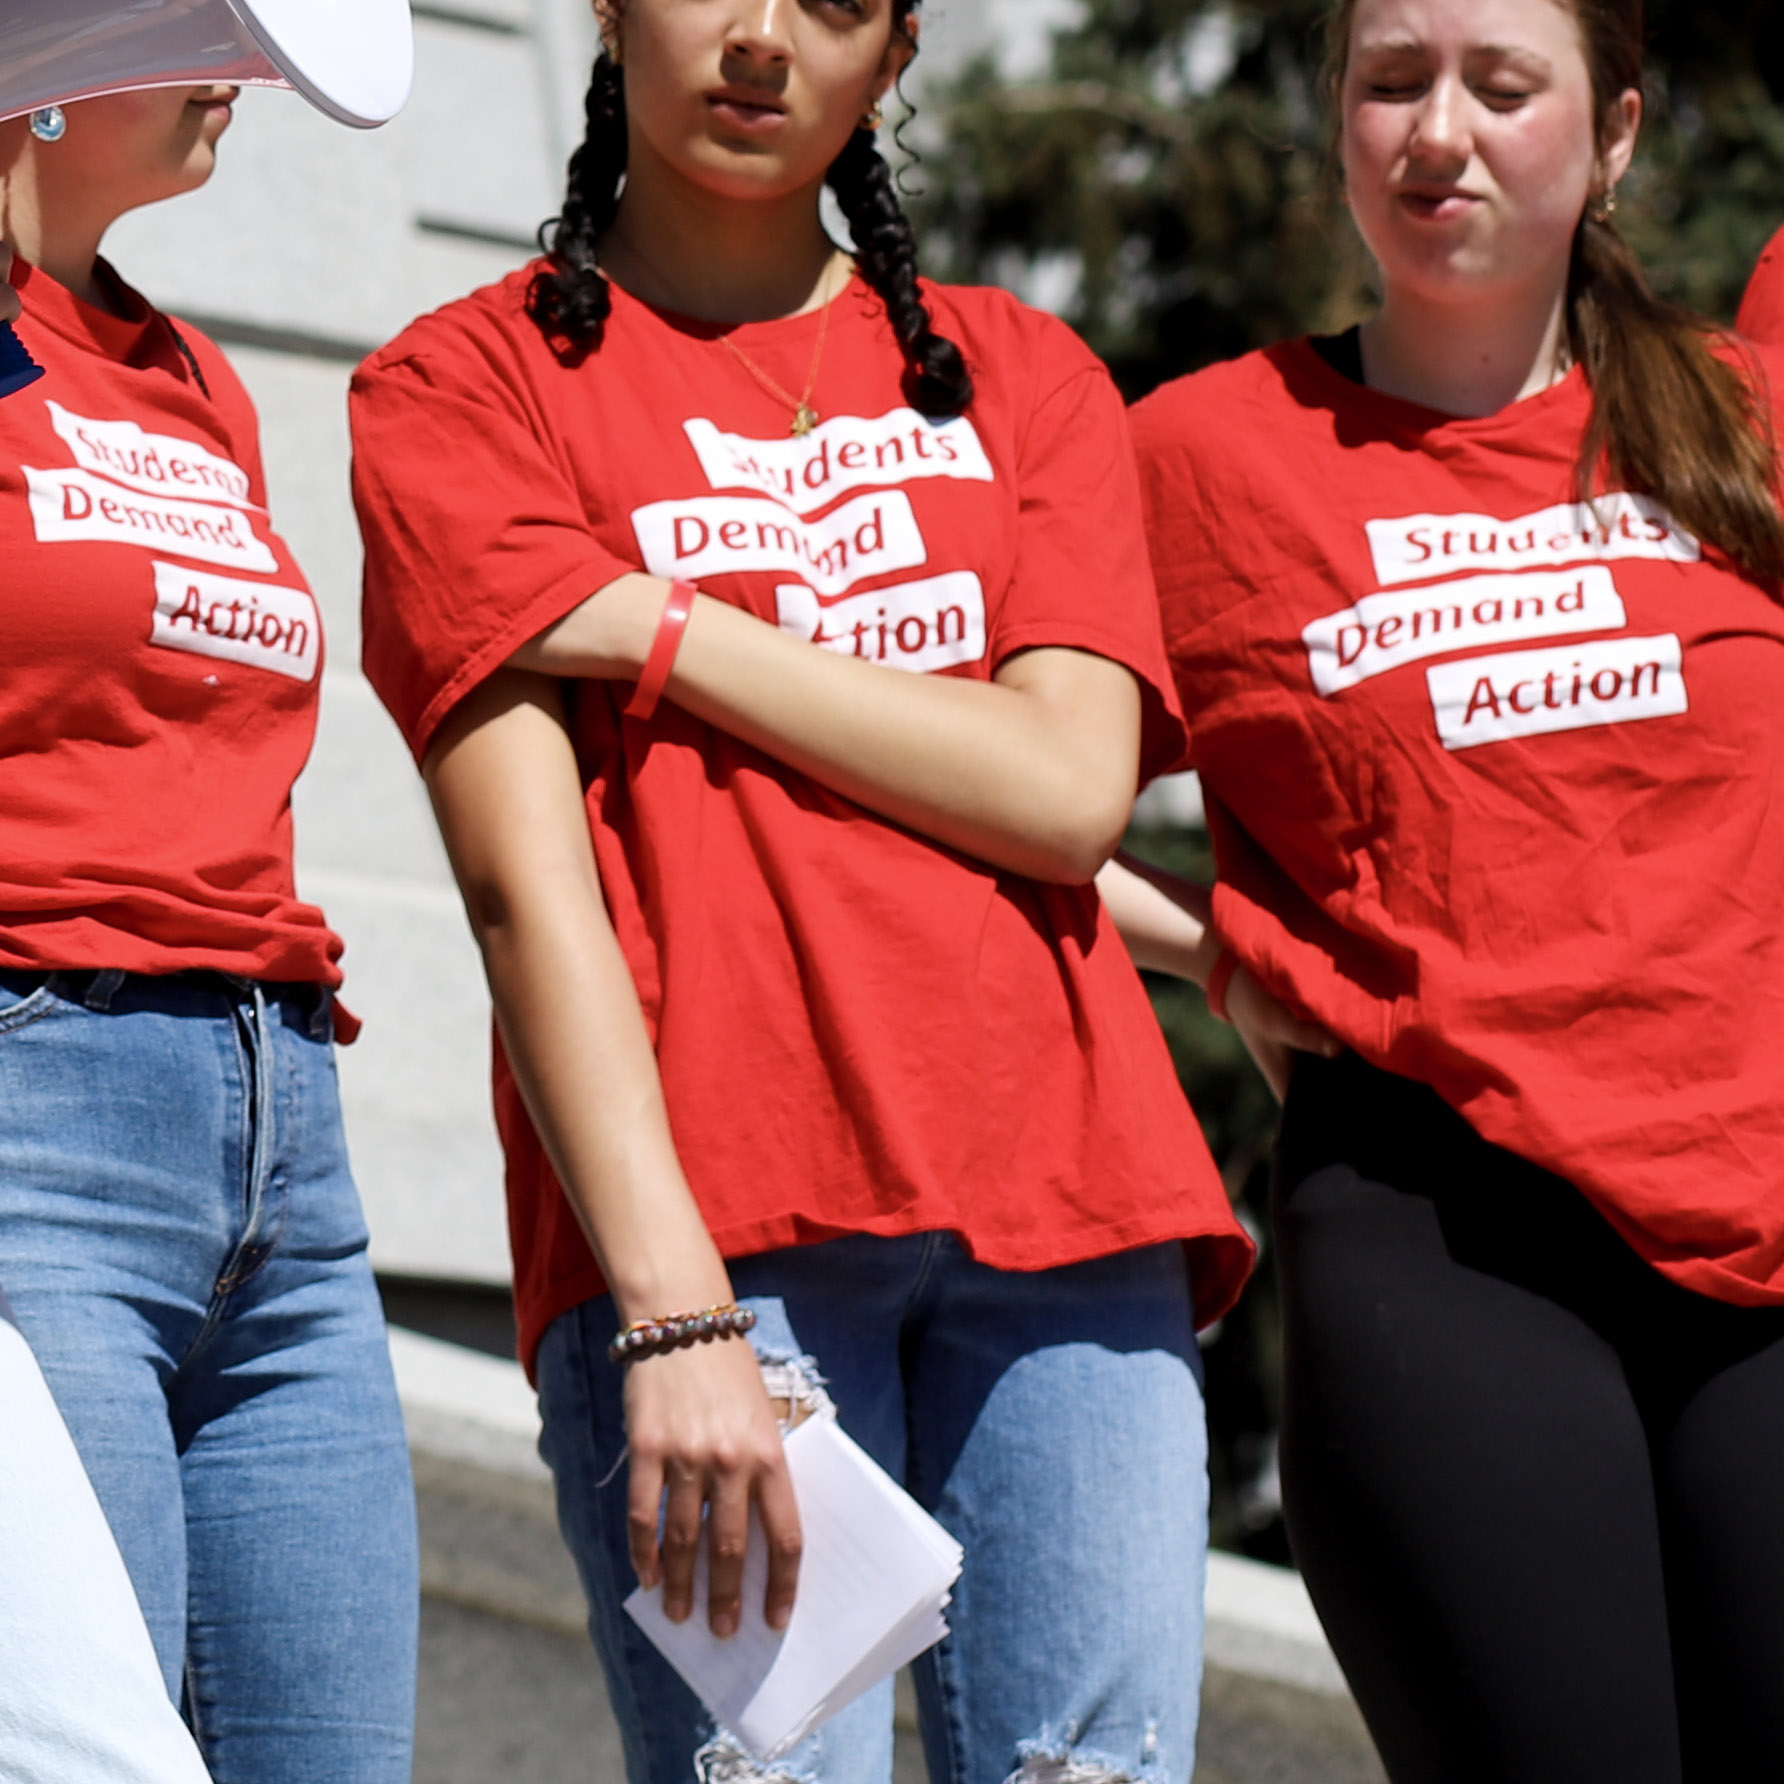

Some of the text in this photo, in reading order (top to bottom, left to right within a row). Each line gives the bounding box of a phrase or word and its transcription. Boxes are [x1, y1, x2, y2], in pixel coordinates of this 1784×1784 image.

[61, 483, 247, 551] Demand
[169, 585, 309, 658] Action
[811, 605, 966, 660] tion
[1333, 580, 1586, 669] Demand
[1462, 659, 1661, 726] Action
